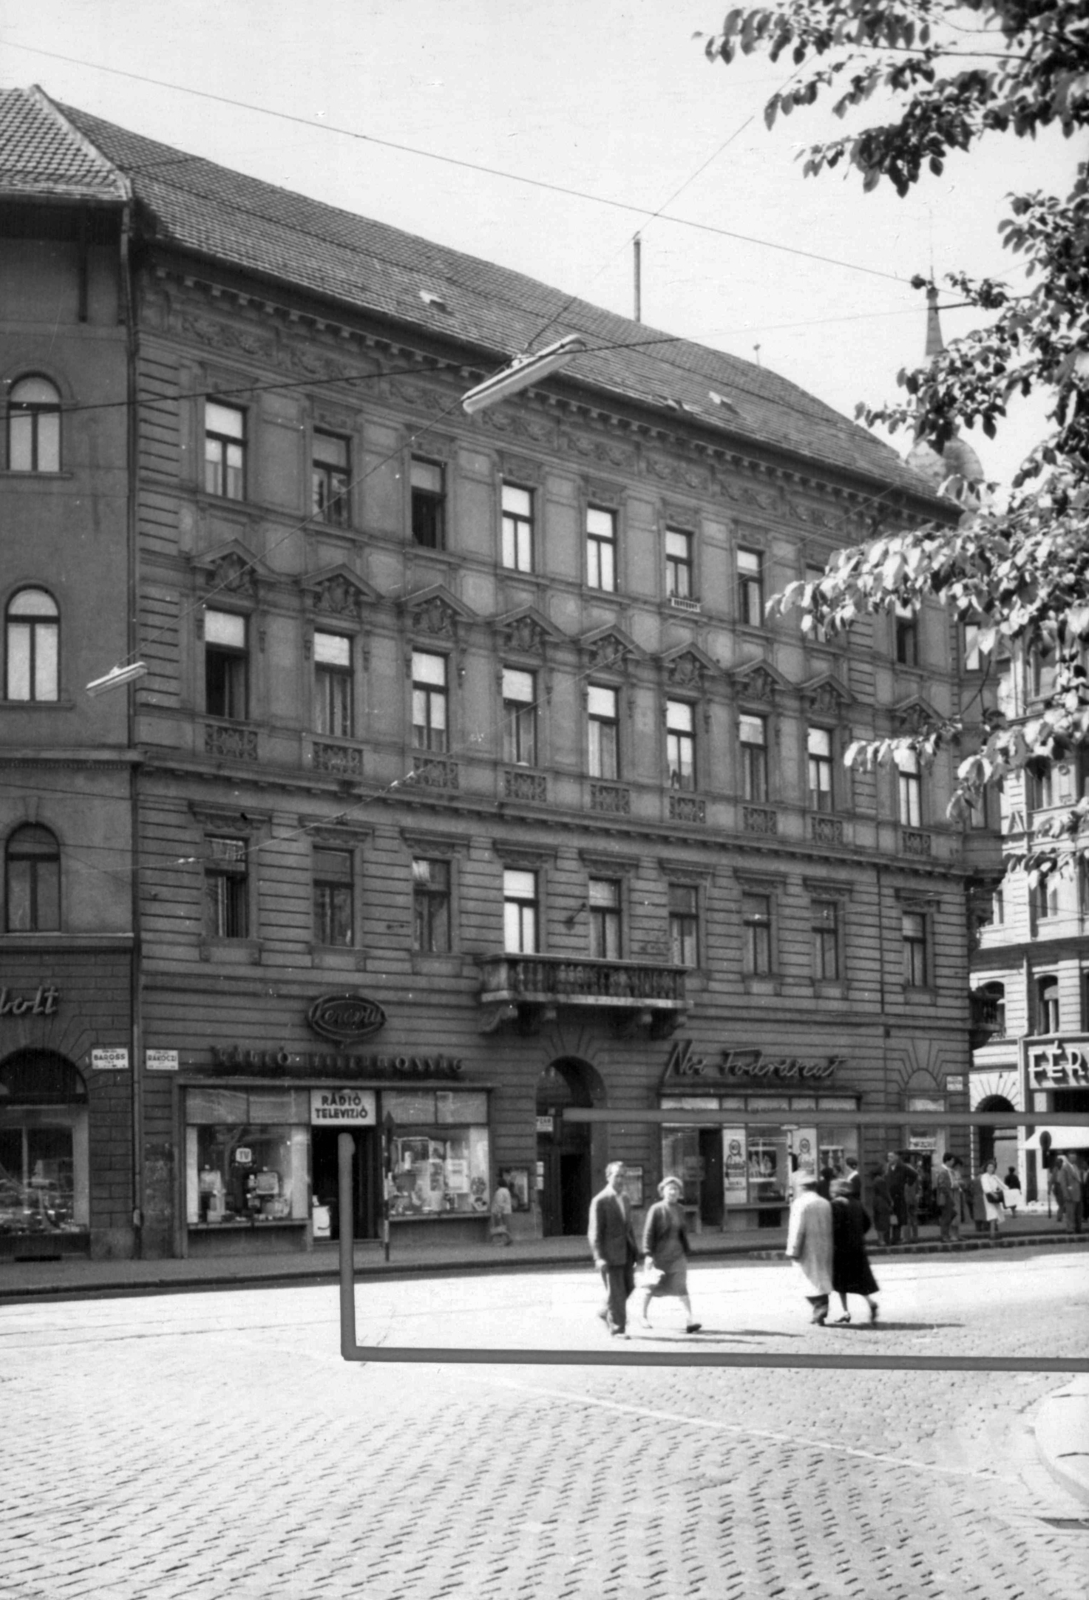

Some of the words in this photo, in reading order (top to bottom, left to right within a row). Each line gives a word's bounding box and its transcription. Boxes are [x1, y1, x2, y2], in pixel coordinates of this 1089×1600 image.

[93, 1053, 126, 1061] BAROSS
[1027, 1039, 1089, 1078] FÉR
[321, 1091, 362, 1106] RÁDIÓ
[315, 1105, 368, 1119] TELEVIZIÓ
